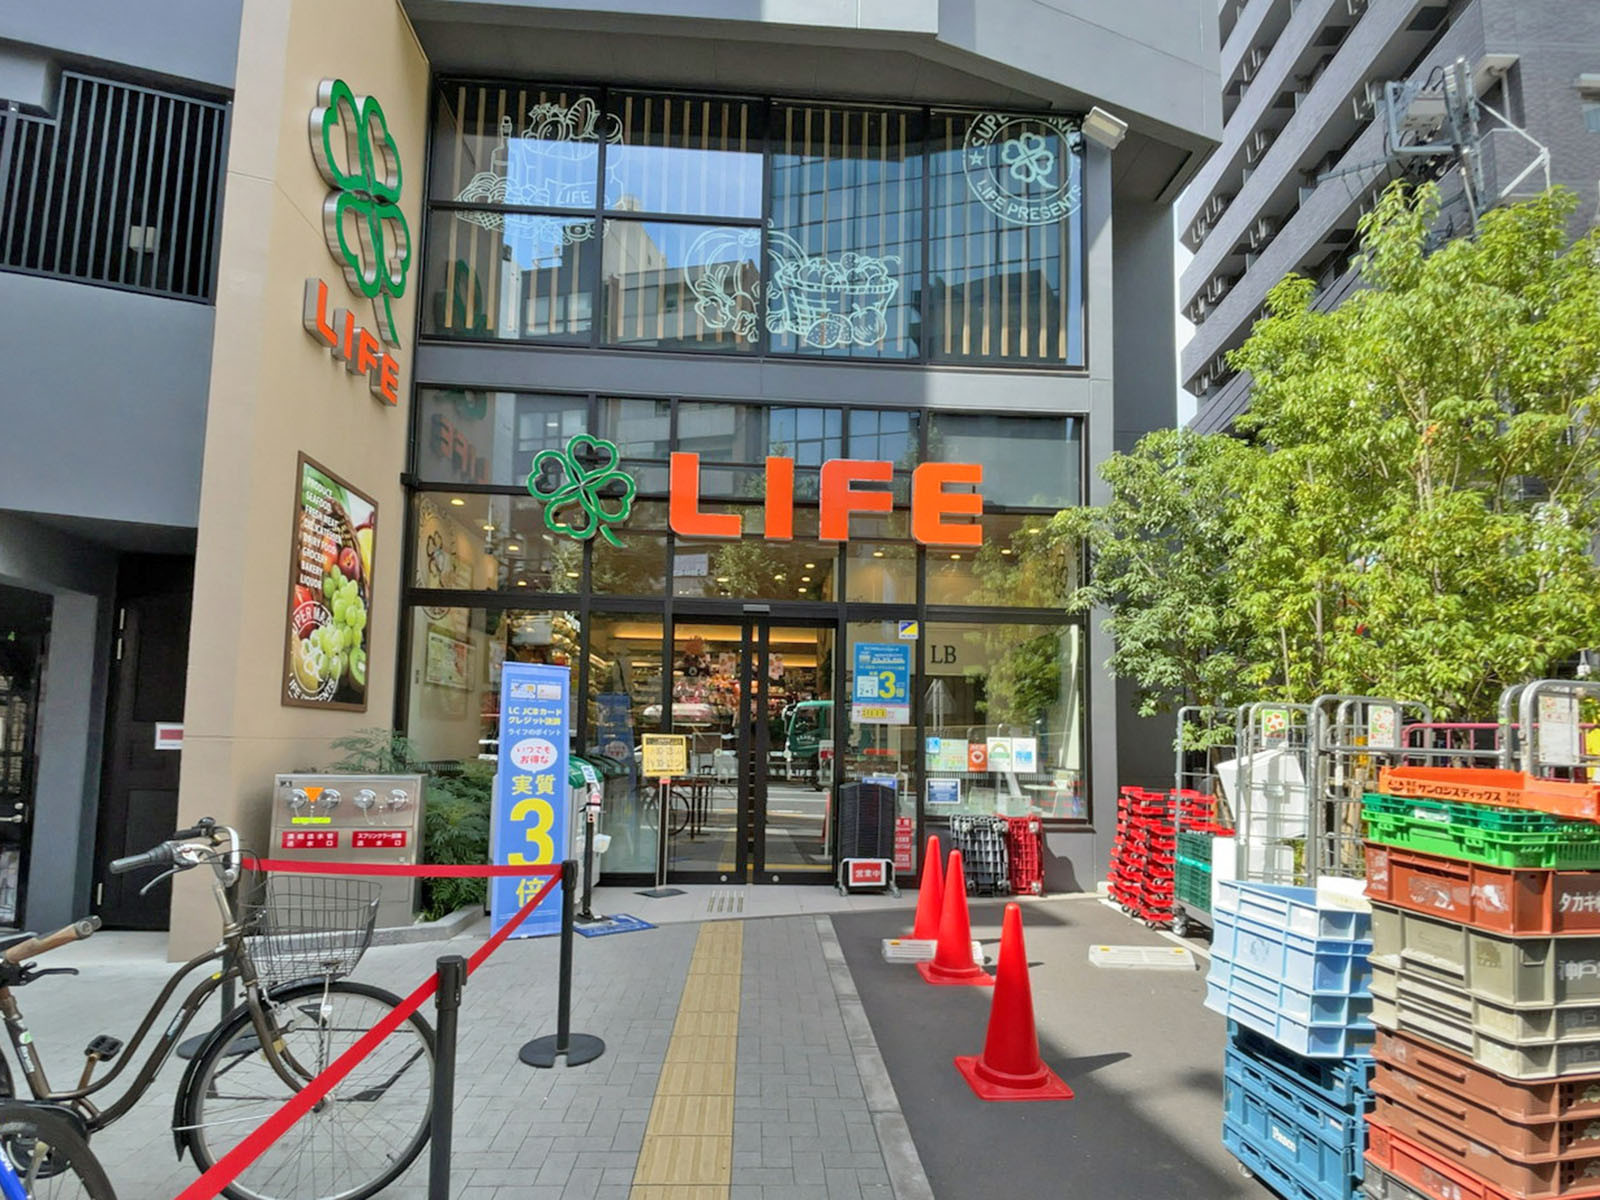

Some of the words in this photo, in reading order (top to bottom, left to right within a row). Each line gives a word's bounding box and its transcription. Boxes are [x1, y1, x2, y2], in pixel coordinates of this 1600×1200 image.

[977, 177, 1007, 211] LIFE
[305, 277, 400, 408] LIFE
[668, 451, 984, 546] LIFE
[930, 644, 957, 665] LB
[878, 671, 897, 699] 3
[511, 773, 557, 797] 実質
[507, 797, 554, 868] 3
[1559, 959, 1600, 981] 神戸
